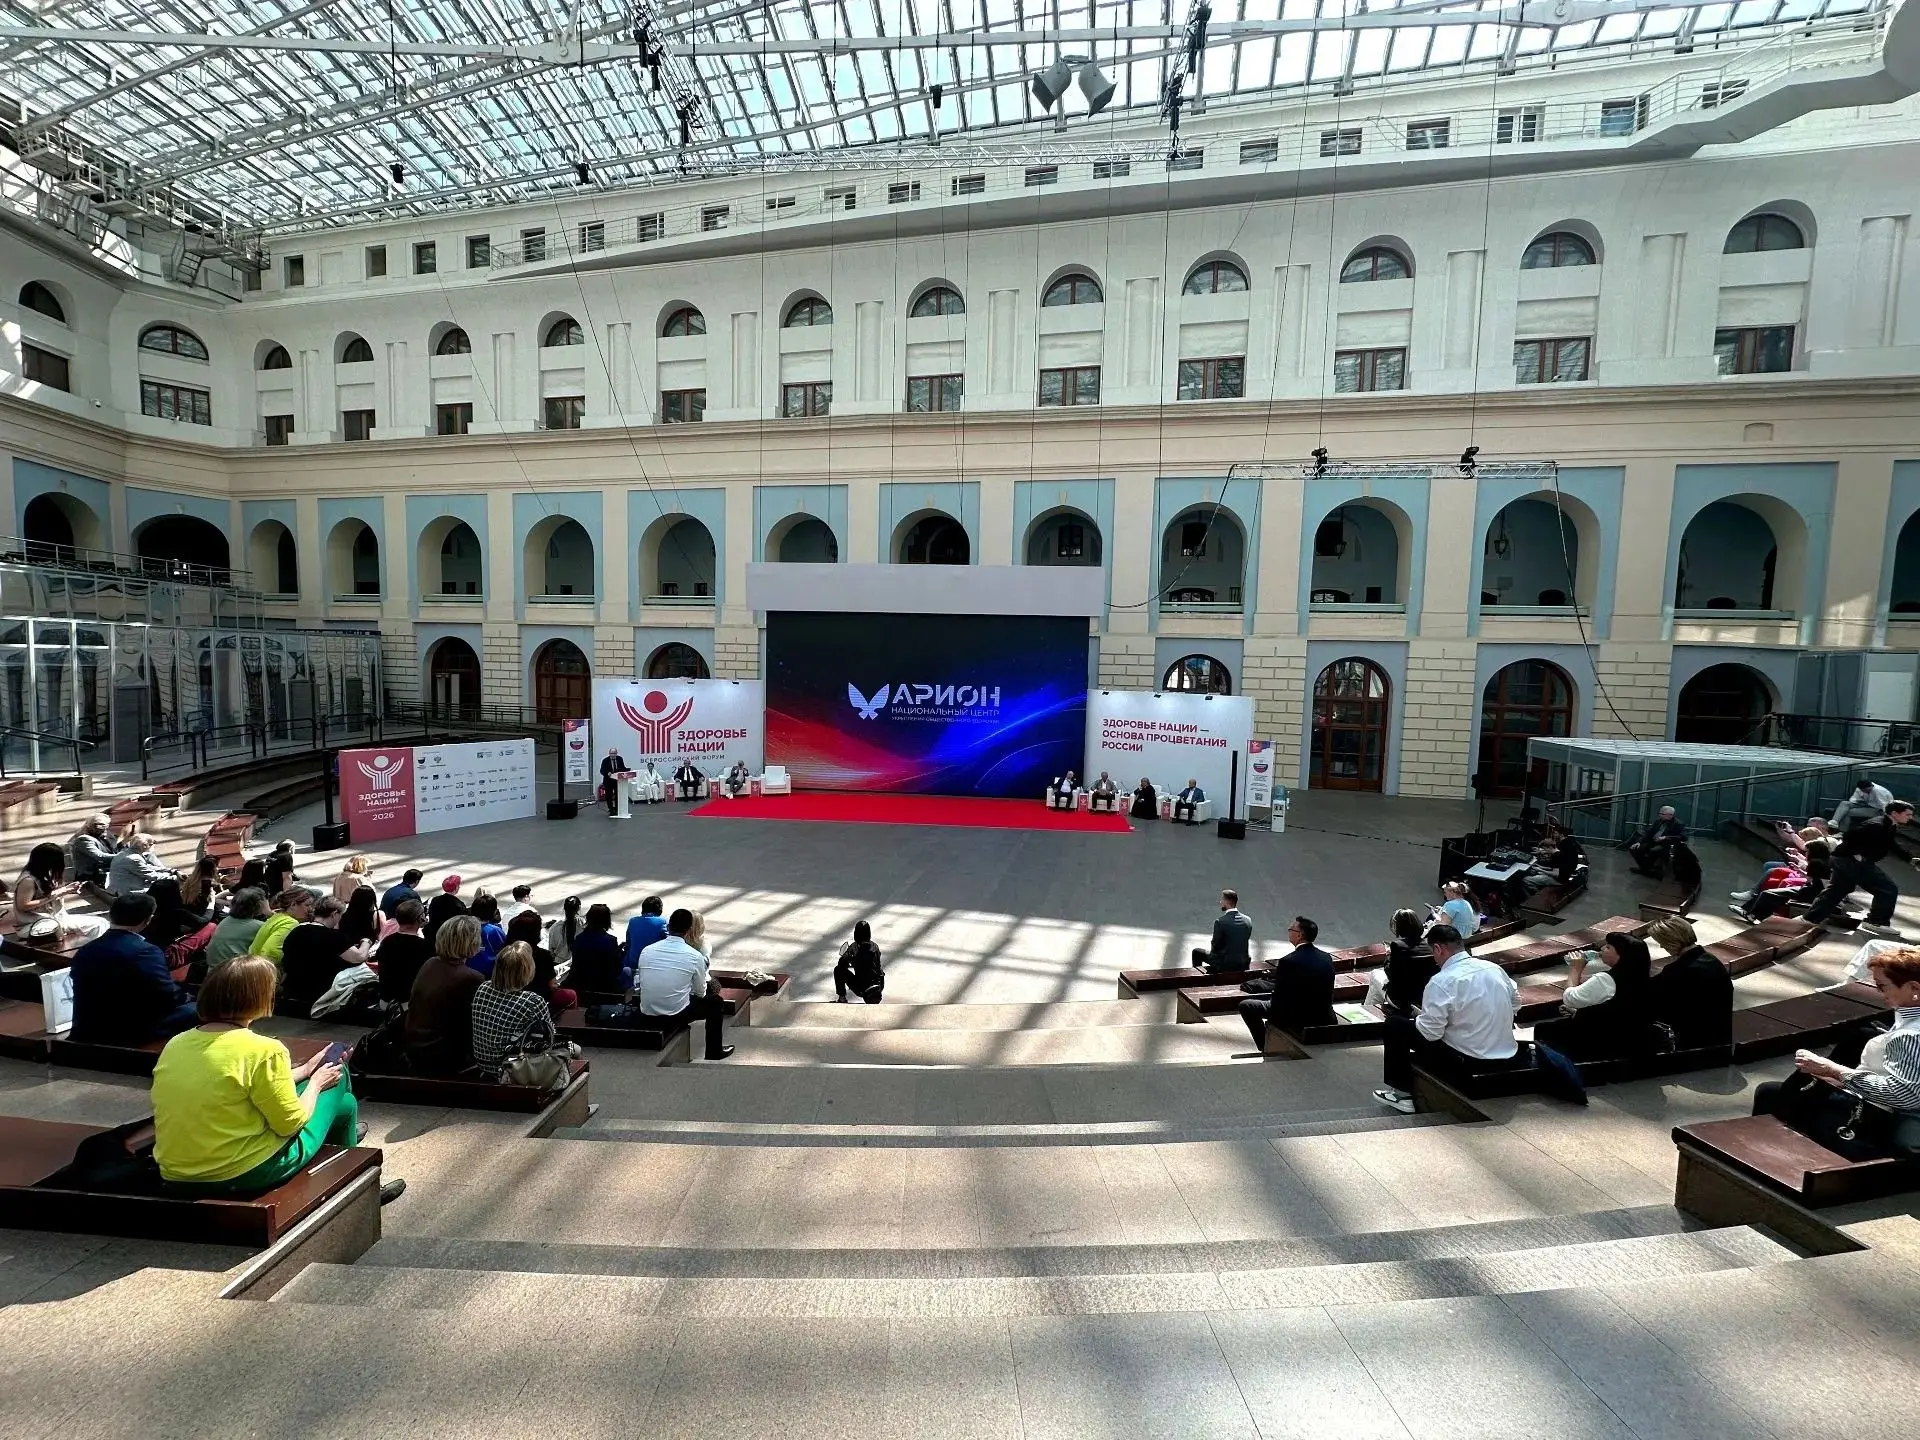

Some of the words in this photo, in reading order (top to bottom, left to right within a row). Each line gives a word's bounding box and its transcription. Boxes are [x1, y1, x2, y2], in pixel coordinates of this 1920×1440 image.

[892, 683, 1000, 706] АРИОН
[892, 707, 968, 716] НАЦИОНАЛЬНЫЙ
[971, 709, 1000, 718] ЦЕНТР
[1102, 719, 1156, 731] ЗДОРОВЬЕ
[1159, 722, 1198, 733] НАЦИИ
[677, 728, 747, 741] ЗДОРОВЬЕ
[1102, 730, 1145, 741] ОСНОВА
[1147, 733, 1227, 748] ПРОЦВЕТАНИЯ
[677, 742, 725, 753] НАЦИИ
[1101, 741, 1143, 752] РОССИИ
[640, 755, 699, 764] ВСЕРОССИЙСКИЙ
[358, 790, 406, 801] ЗДОРОВЬЕ
[366, 797, 399, 806] НАЦИИ
[372, 812, 395, 821] 2026
